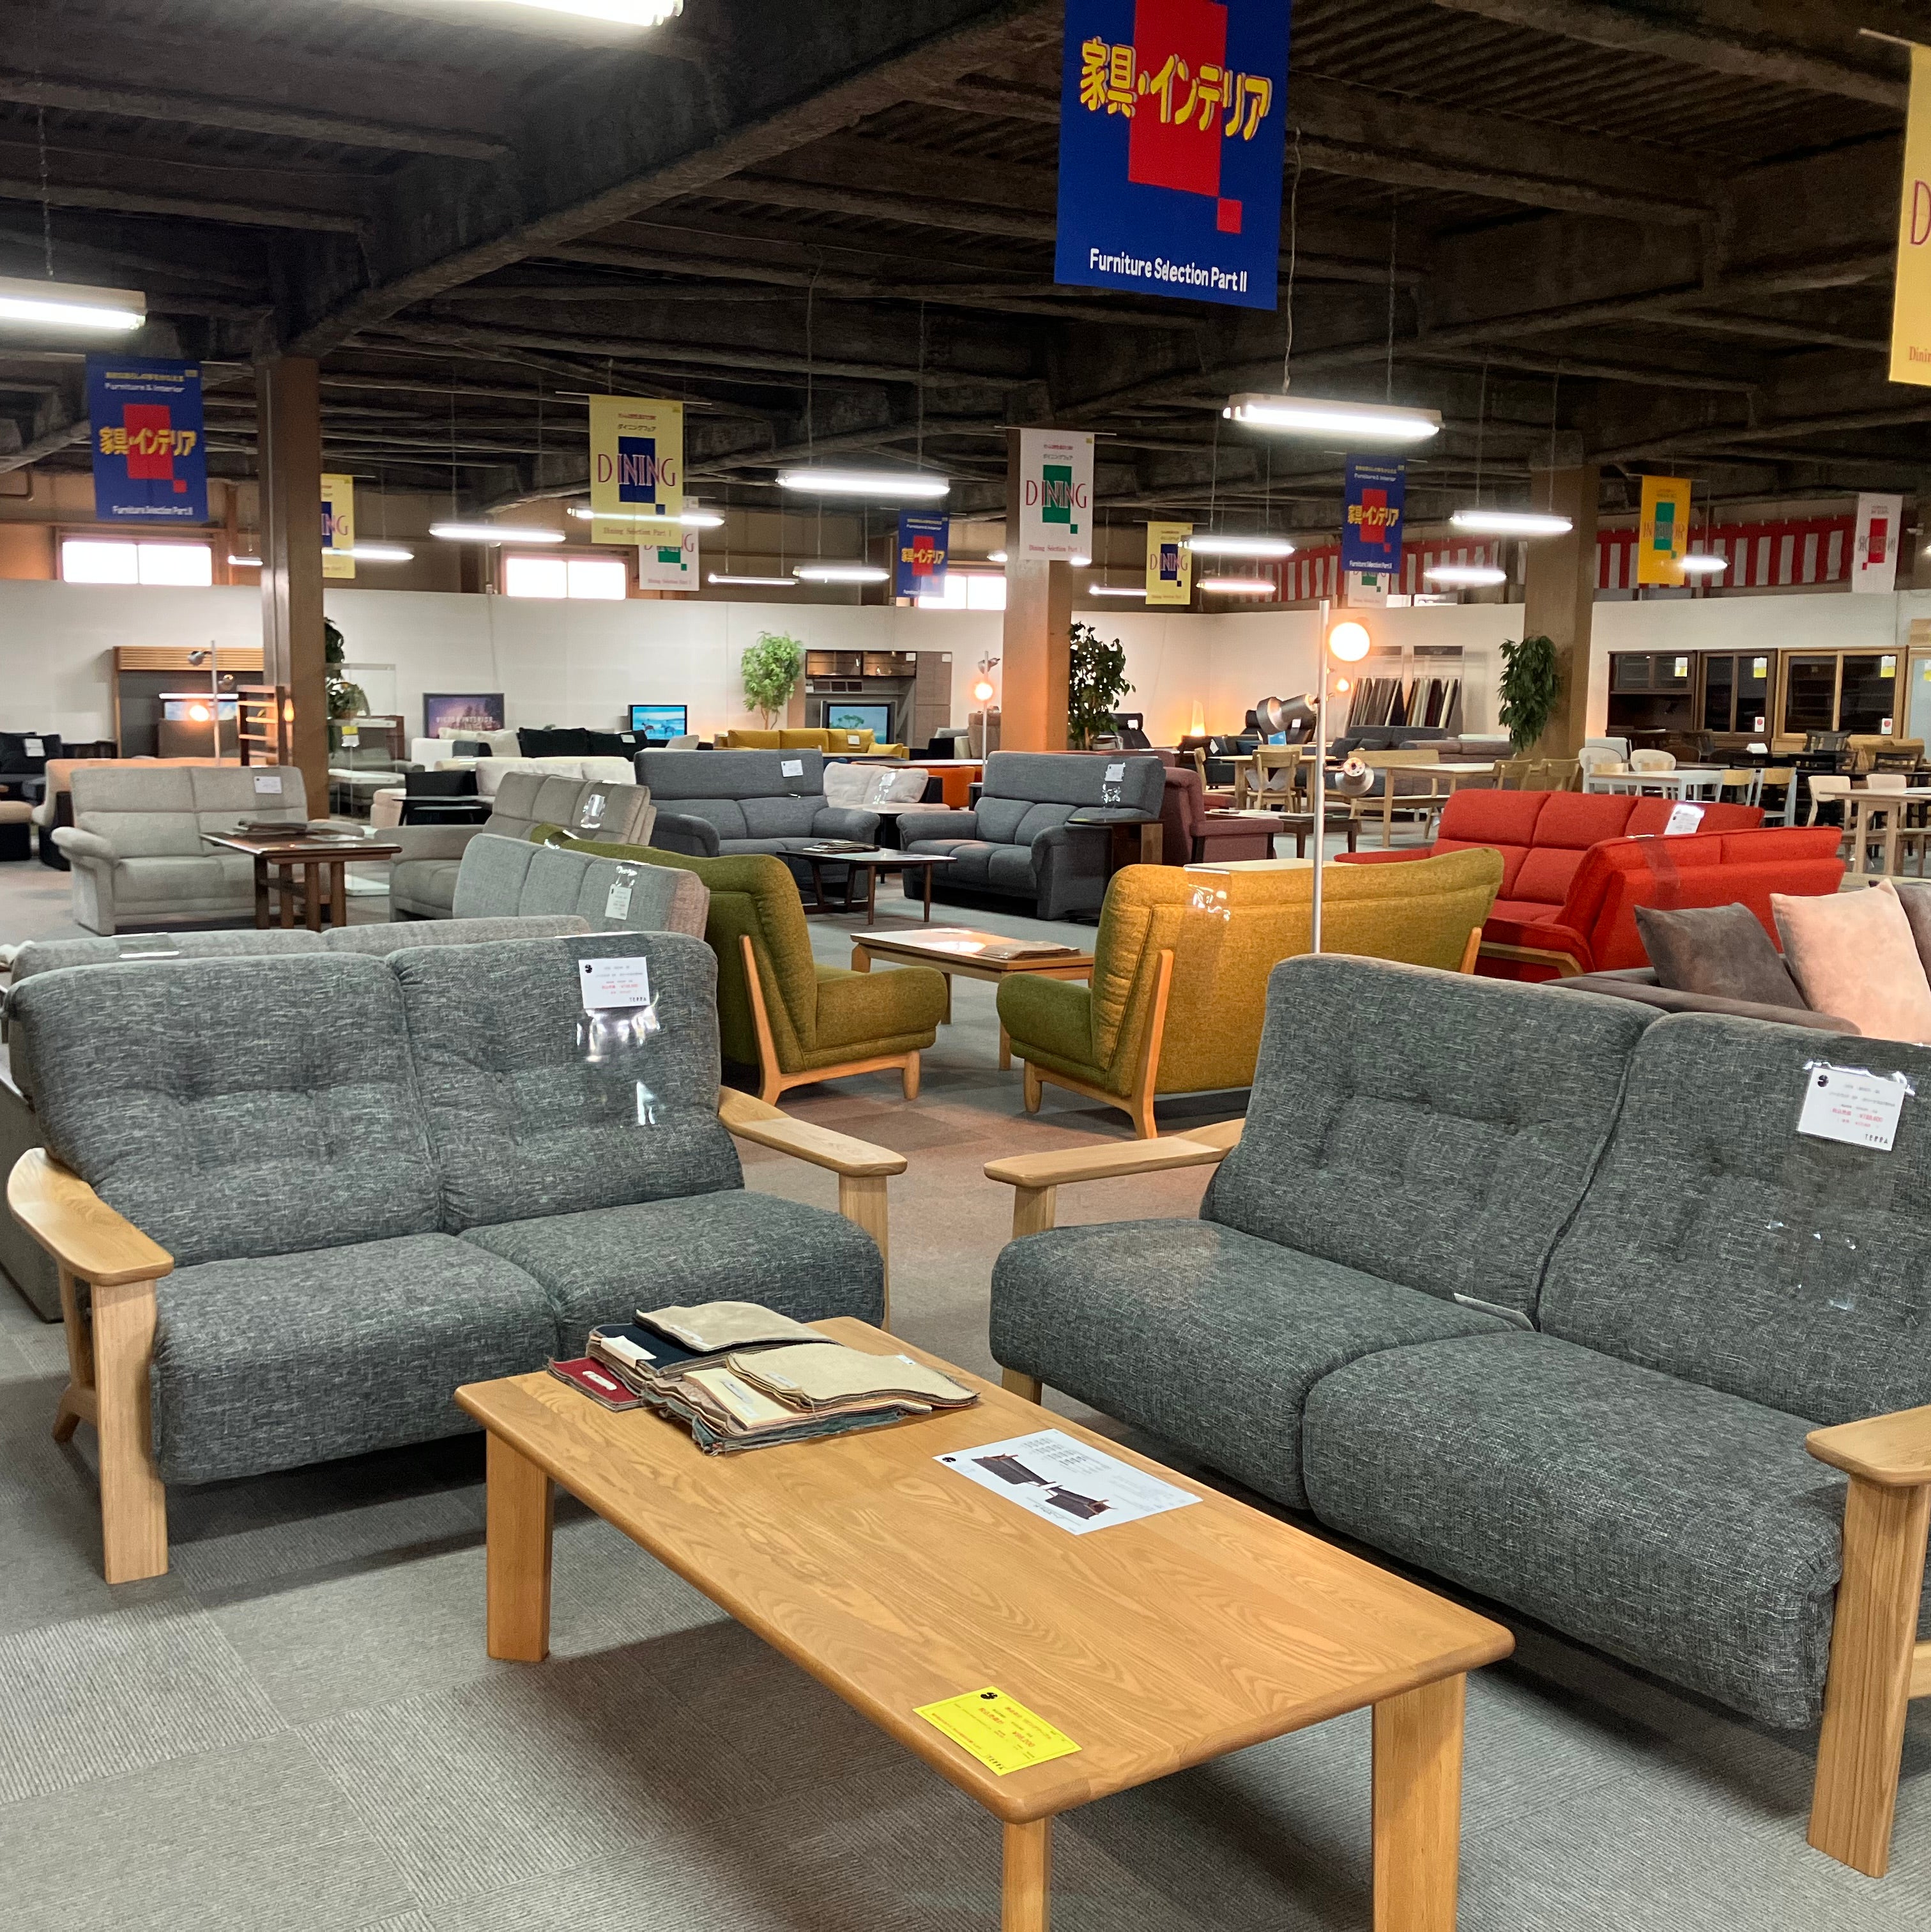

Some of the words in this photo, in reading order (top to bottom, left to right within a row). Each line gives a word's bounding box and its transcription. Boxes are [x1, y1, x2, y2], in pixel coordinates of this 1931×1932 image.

[1090, 248, 1152, 278] Furniture
[1154, 257, 1209, 286] Selection
[1210, 266, 1237, 291] Part
[598, 454, 676, 486] DINING
[1026, 480, 1087, 509] DINING
[1150, 553, 1188, 571] DINING
